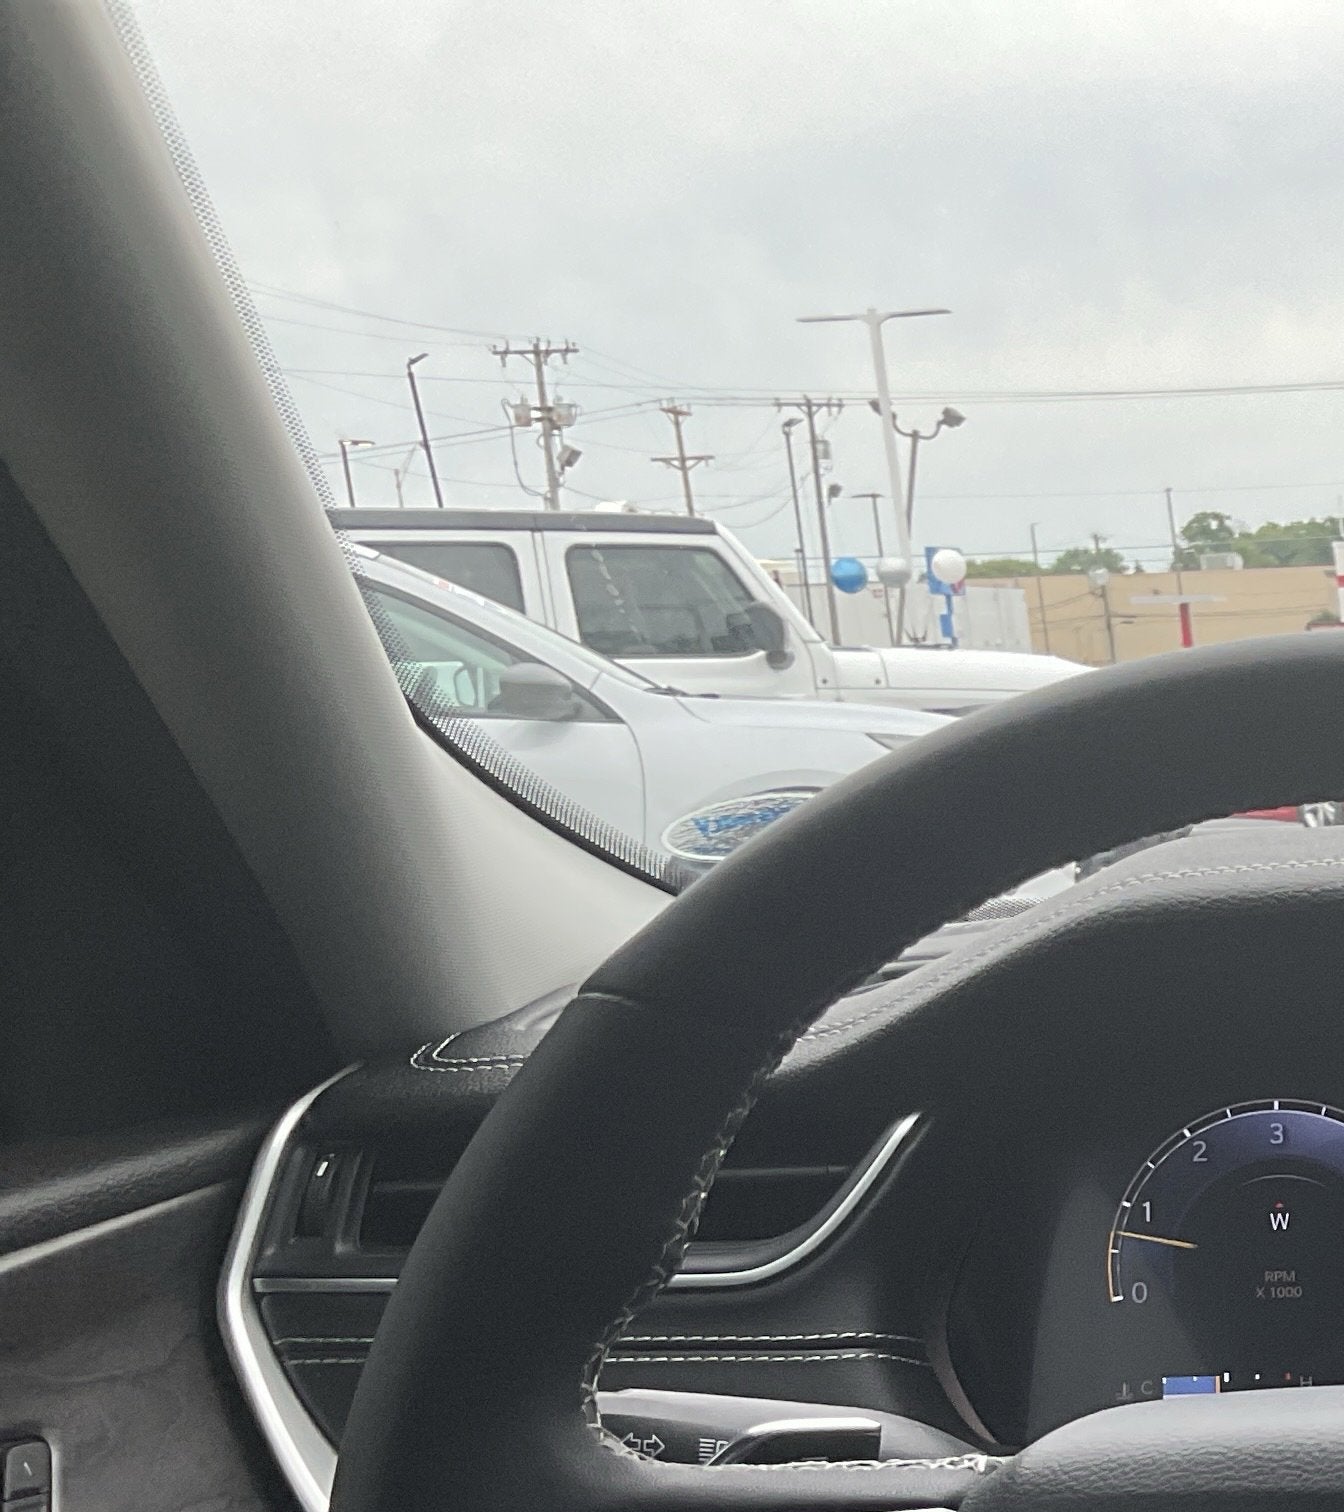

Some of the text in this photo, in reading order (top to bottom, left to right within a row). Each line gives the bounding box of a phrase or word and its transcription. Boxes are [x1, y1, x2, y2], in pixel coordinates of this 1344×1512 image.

[1270, 1123, 1285, 1144] 3
[1192, 1140, 1209, 1162] 2
[1142, 1200, 1151, 1222] 1
[1269, 1212, 1290, 1231] W
[1264, 1270, 1296, 1283] RPM
[1131, 1281, 1148, 1304] 0
[1255, 1286, 1303, 1298] X 1000
[1140, 1381, 1154, 1395] C
